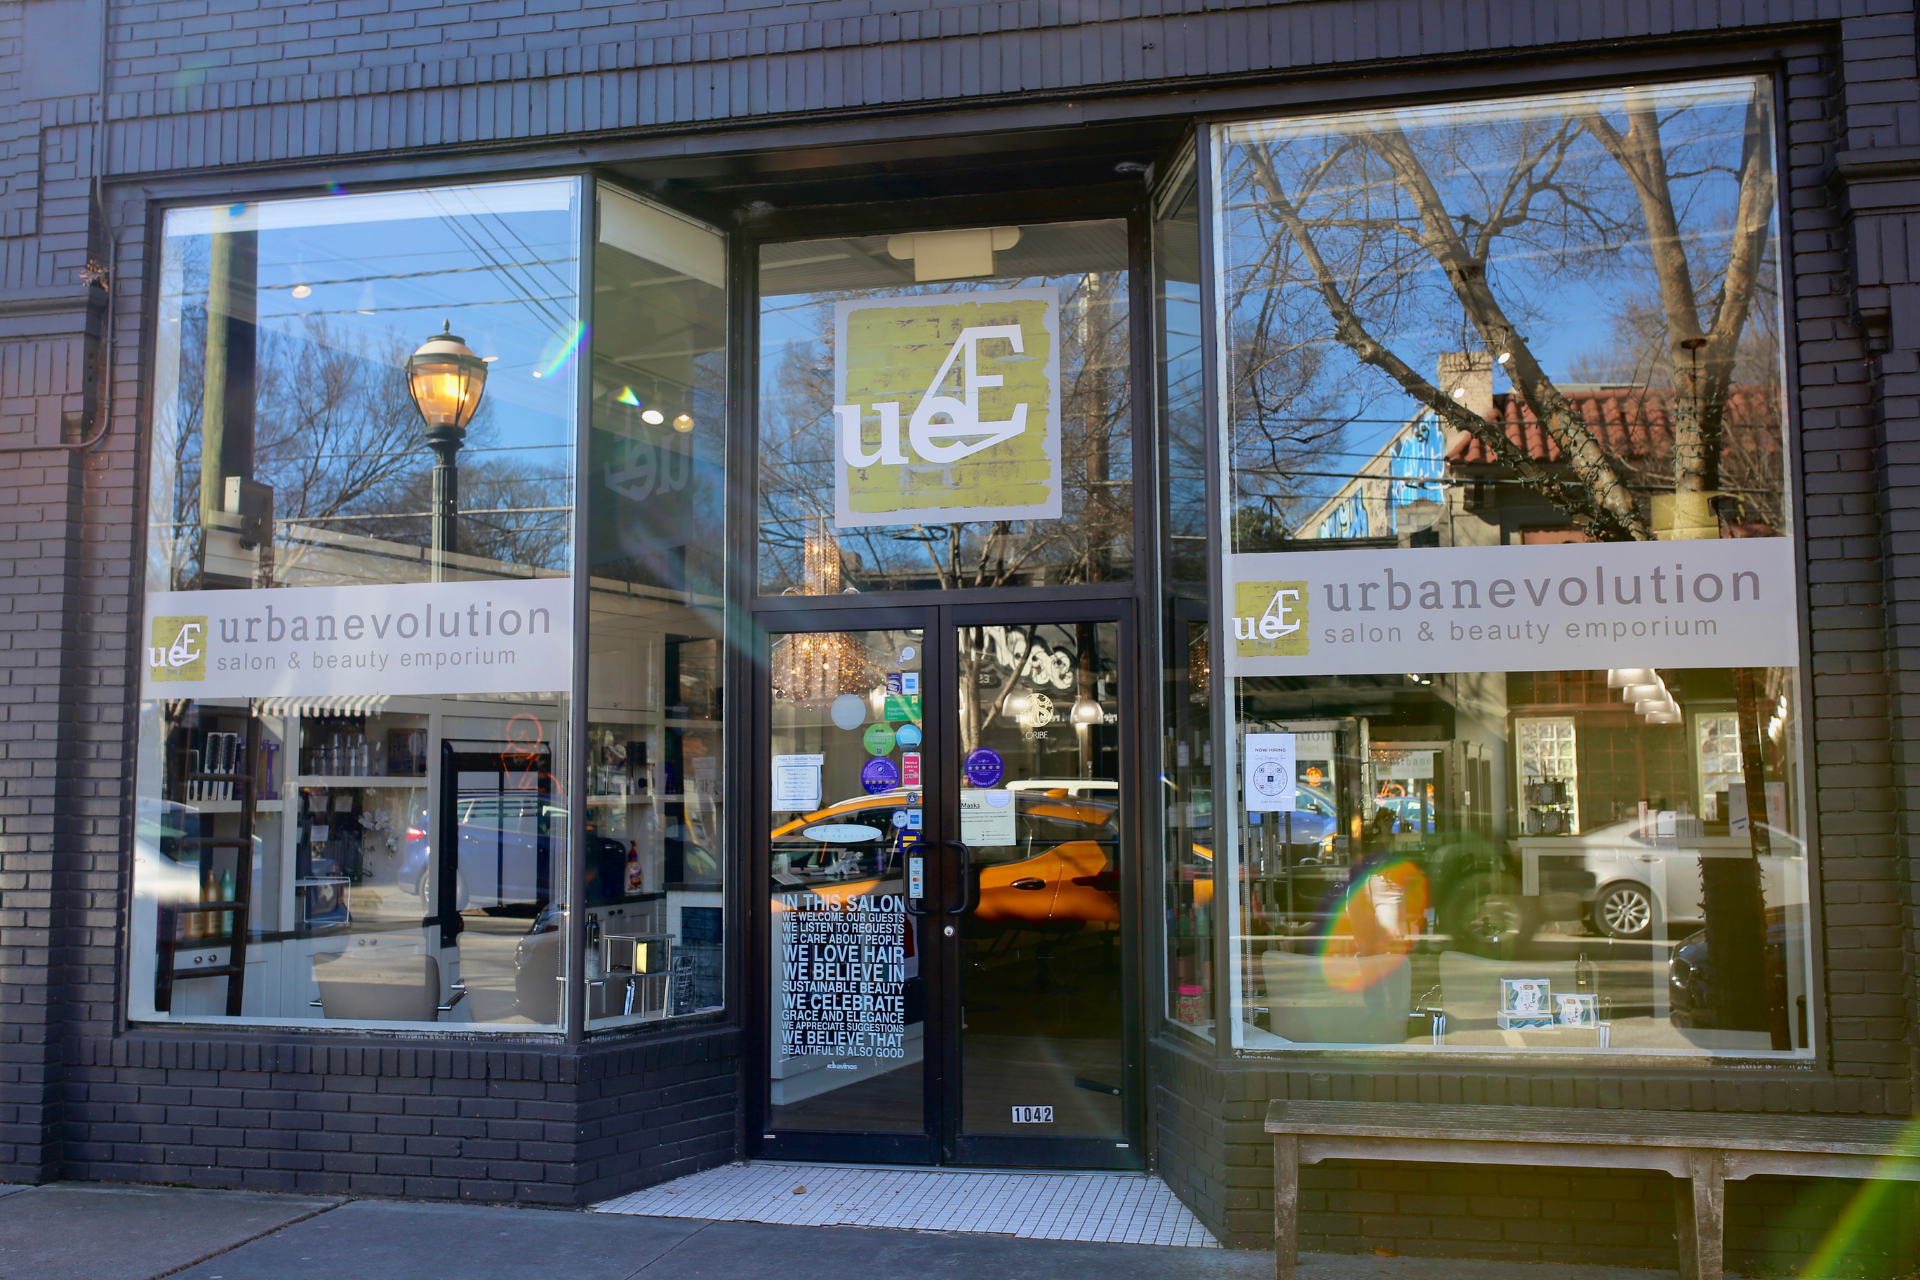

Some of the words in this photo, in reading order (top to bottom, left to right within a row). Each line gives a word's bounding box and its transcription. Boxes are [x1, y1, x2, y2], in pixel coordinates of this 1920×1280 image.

[1323, 562, 1761, 613] urbanevolution
[218, 600, 552, 644] urbanevolution
[1323, 621, 1402, 644] salon
[1416, 620, 1435, 643] &
[1450, 619, 1550, 645] beauty
[1565, 615, 1718, 643] emporium
[217, 651, 277, 671] salon
[287, 651, 301, 670] &
[312, 649, 390, 673] beauty
[399, 647, 517, 671] emporium
[1025, 731, 1049, 740] ORIBE
[782, 894, 798, 911] IN
[803, 894, 841, 911] THIS
[846, 894, 905, 912] SALON
[783, 912, 796, 921] WE
[799, 912, 844, 922] WELCOME
[847, 912, 865, 922] OUR
[868, 913, 905, 923] GUESTS
[783, 922, 797, 932] WE
[801, 923, 833, 932] LISTEN
[836, 923, 849, 932] TO
[852, 923, 904, 933] REQUESTS
[783, 934, 797, 943] WE
[800, 934, 826, 943] CARE
[829, 934, 863, 944] ABOUT
[866, 935, 904, 945] PEOPLE
[783, 945, 808, 961] WE
[814, 945, 858, 962] LOVE
[864, 946, 904, 963] HAIR
[783, 963, 808, 980] WE
[814, 963, 883, 981] BELIEVE
[888, 964, 904, 982] IN
[782, 981, 856, 993] SUSTAINABLE
[860, 983, 903, 994] BEAUTY
[782, 994, 806, 1009] WE
[811, 994, 904, 1012] CELEBRATE
[782, 1010, 818, 1021] GRACE
[821, 1011, 843, 1021] AND
[847, 1011, 904, 1023] ELEGANCE
[782, 1021, 794, 1029] WE
[796, 1022, 844, 1030] APPRECIATE
[847, 1023, 904, 1032] SUGGESTIONS
[782, 1030, 802, 1044] WE
[807, 1031, 864, 1045] BELIEVE
[868, 1033, 903, 1047] THAT
[782, 1045, 833, 1055] BEAUTIFUL
[836, 1046, 844, 1055] IS
[847, 1047, 873, 1056] ALSO
[876, 1048, 904, 1058] GOOD
[1015, 1107, 1052, 1122] 1042
